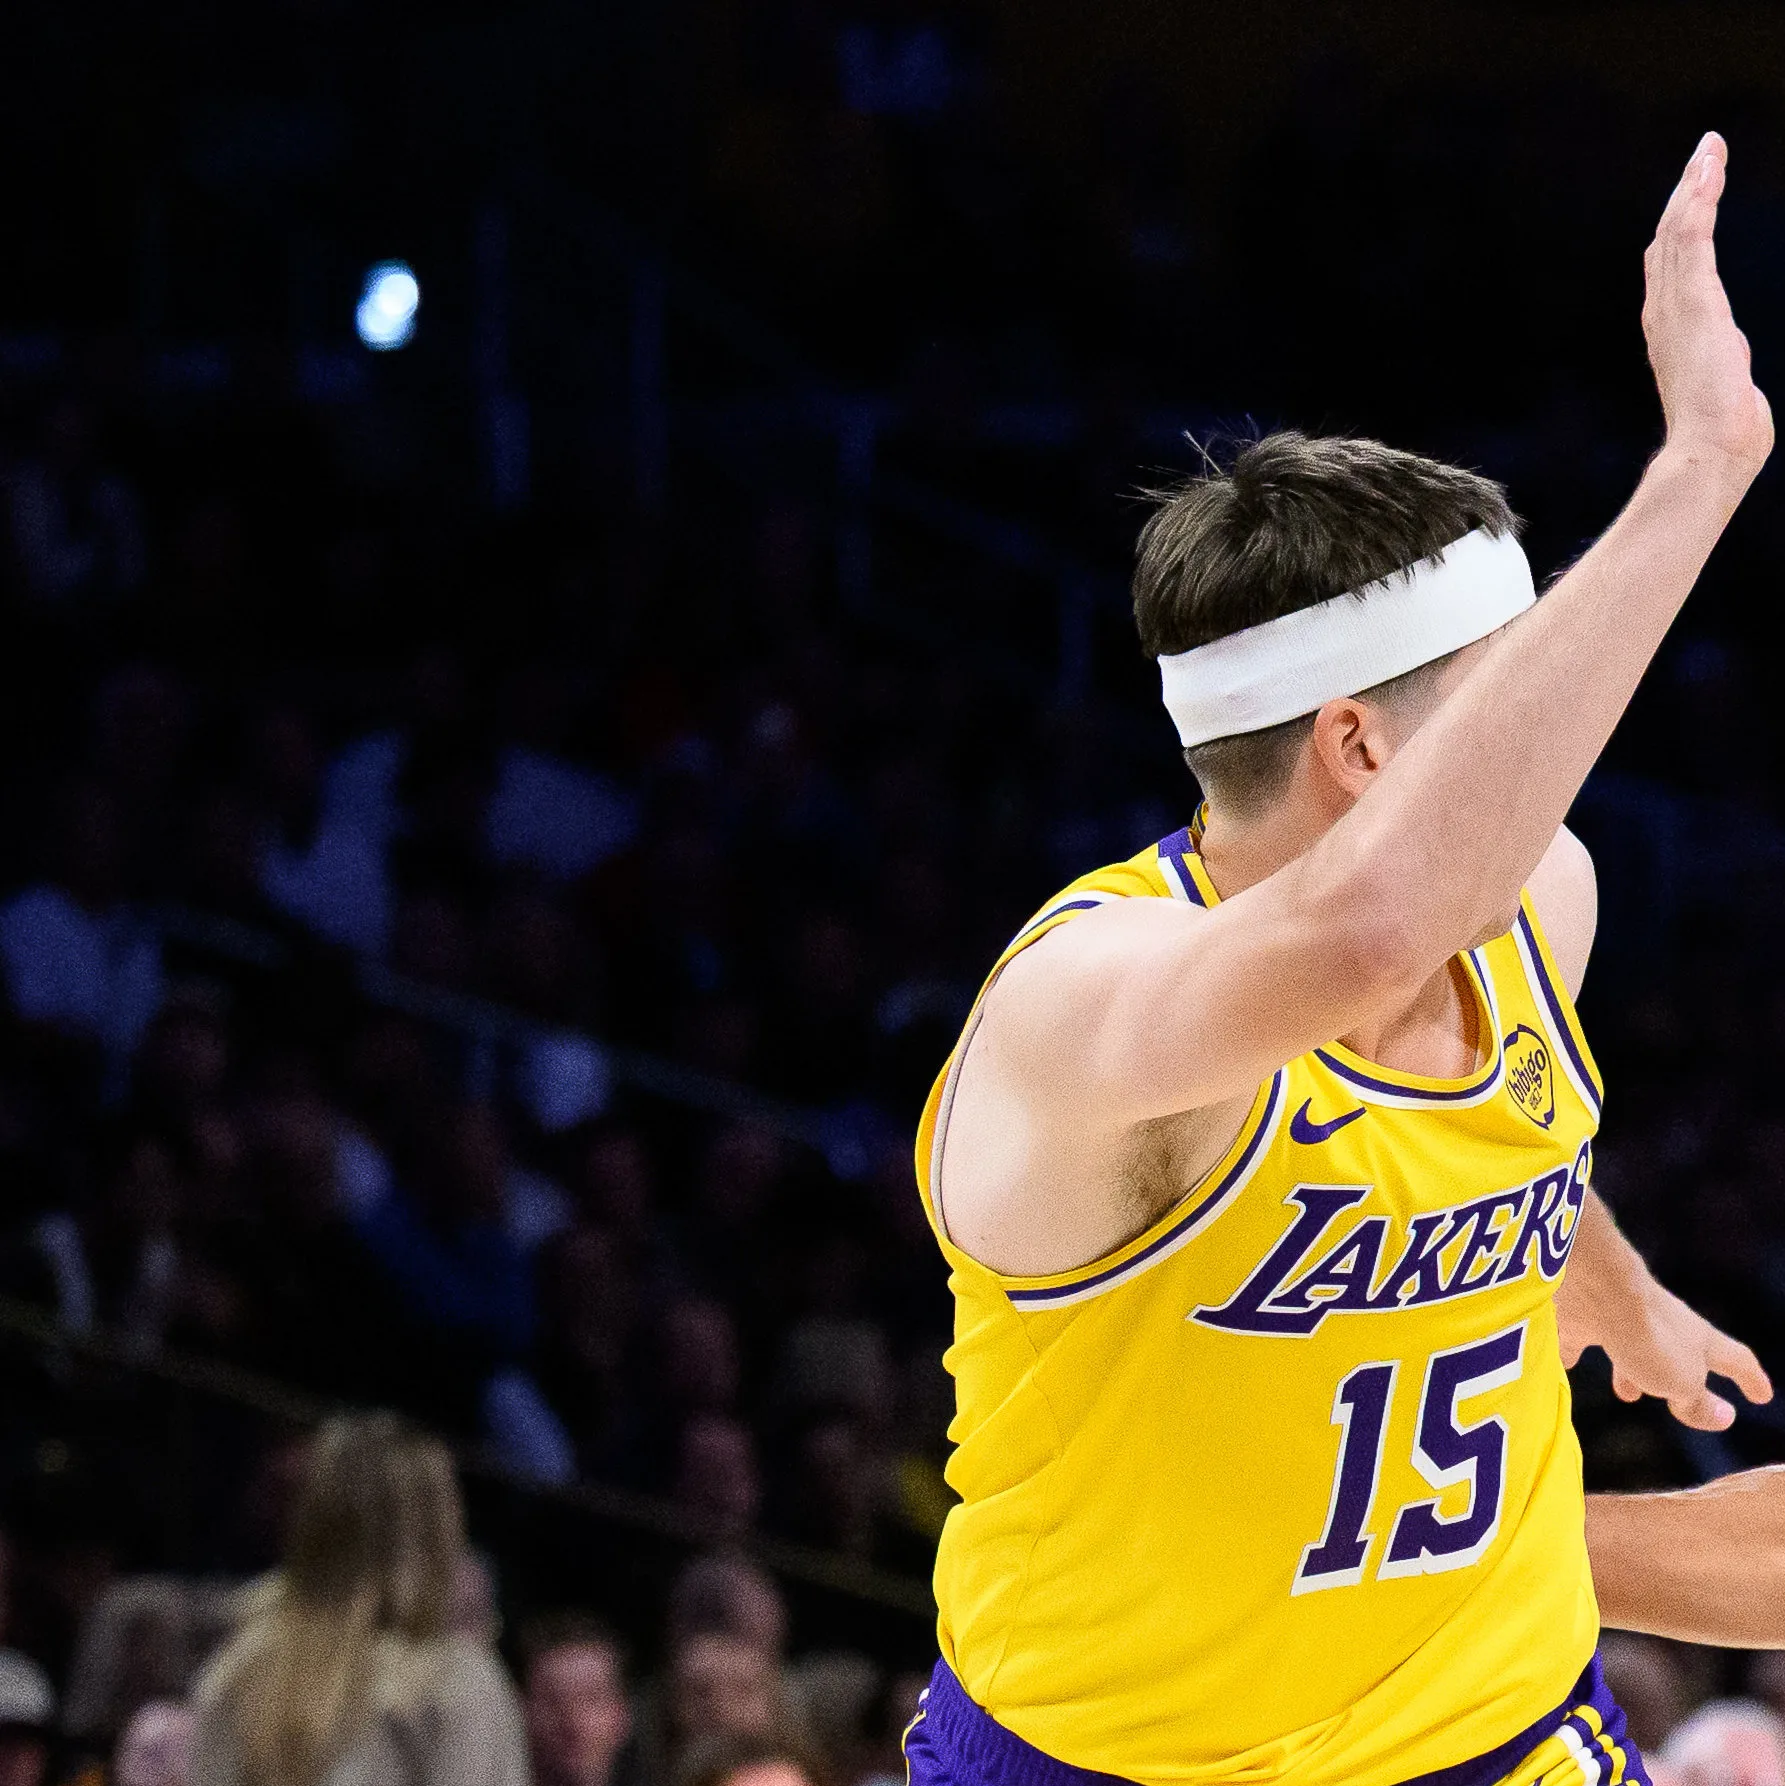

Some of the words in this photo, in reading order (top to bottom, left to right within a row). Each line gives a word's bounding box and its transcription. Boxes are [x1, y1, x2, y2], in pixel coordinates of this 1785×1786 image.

[1508, 1049, 1546, 1104] bibigo
[1187, 1136, 1593, 1337] LAKERS
[1290, 1319, 1529, 1597] 15
